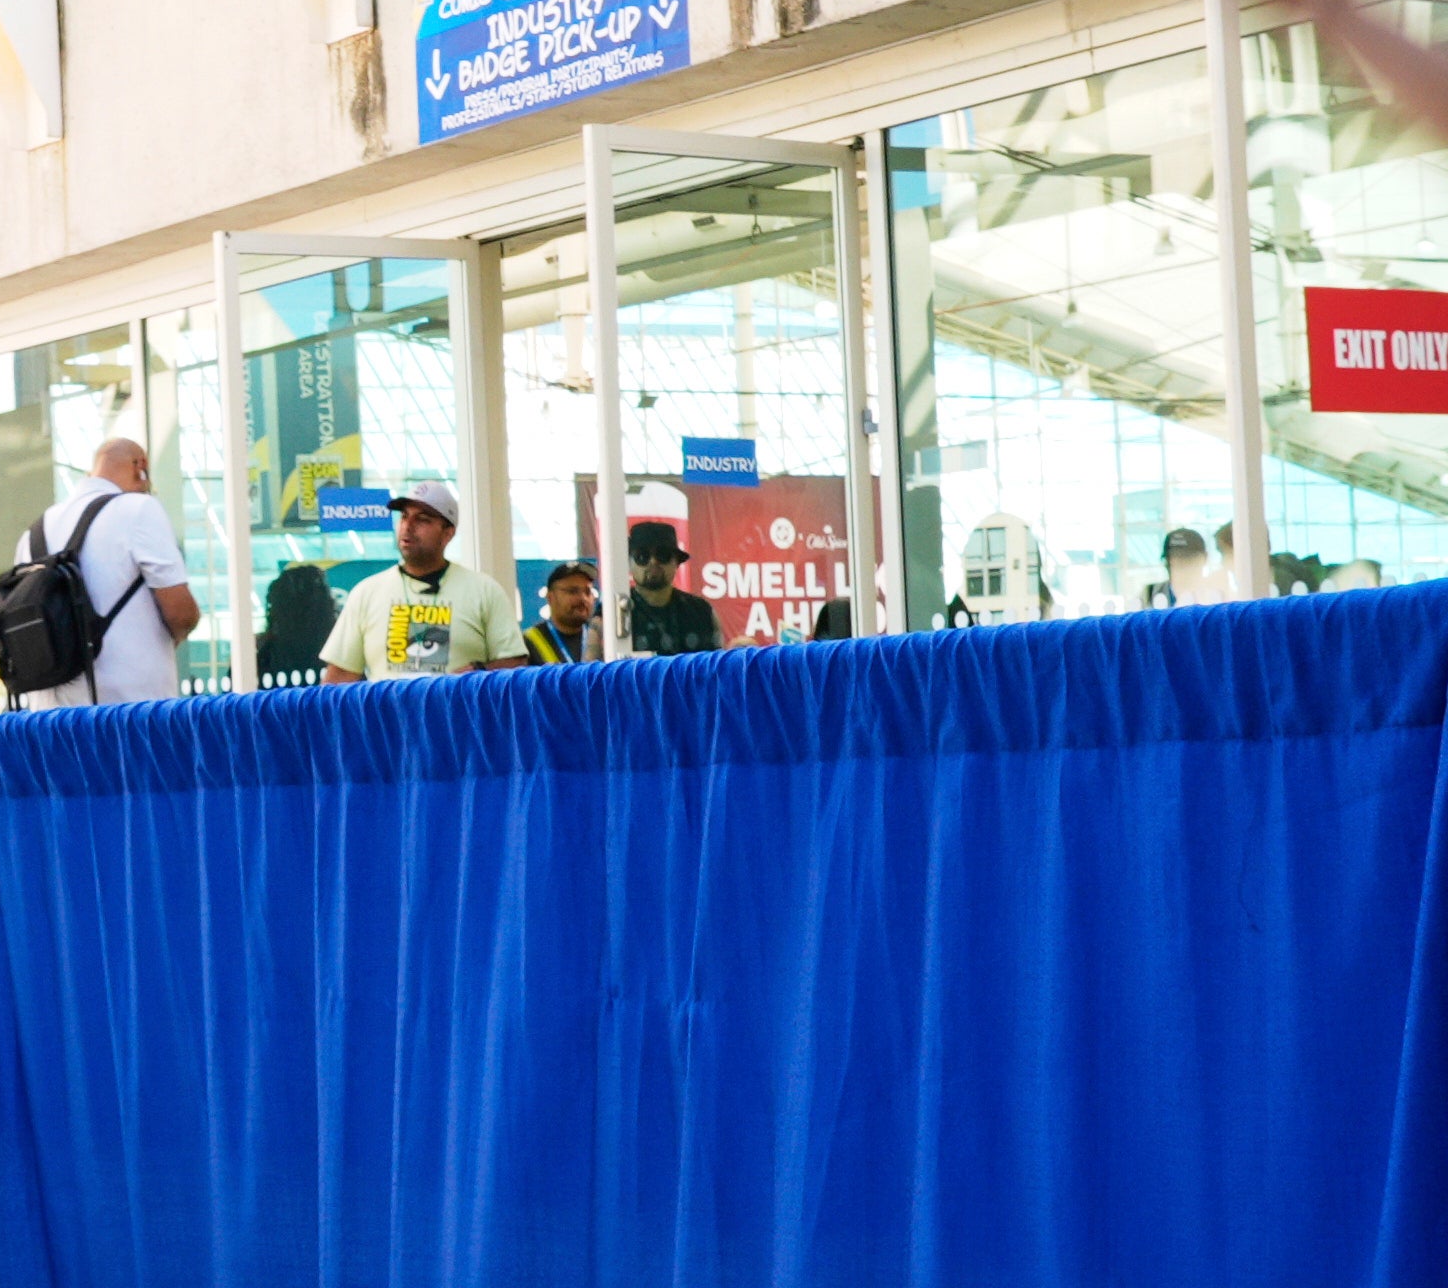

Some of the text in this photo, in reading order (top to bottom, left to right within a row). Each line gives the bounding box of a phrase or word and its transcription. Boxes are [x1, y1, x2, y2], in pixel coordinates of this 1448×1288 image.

[458, 6, 641, 91] BADGE PICK-UP
[604, 50, 664, 82] RELATIONS
[1333, 328, 1387, 370] EXIT
[297, 348, 315, 399] AREA
[686, 455, 756, 473] INDUSTRY
[322, 504, 392, 520] INDUSTRY
[701, 562, 826, 599] SMELL
[410, 604, 452, 626] CON
[744, 601, 774, 637] A
[387, 604, 410, 665] COMIC
